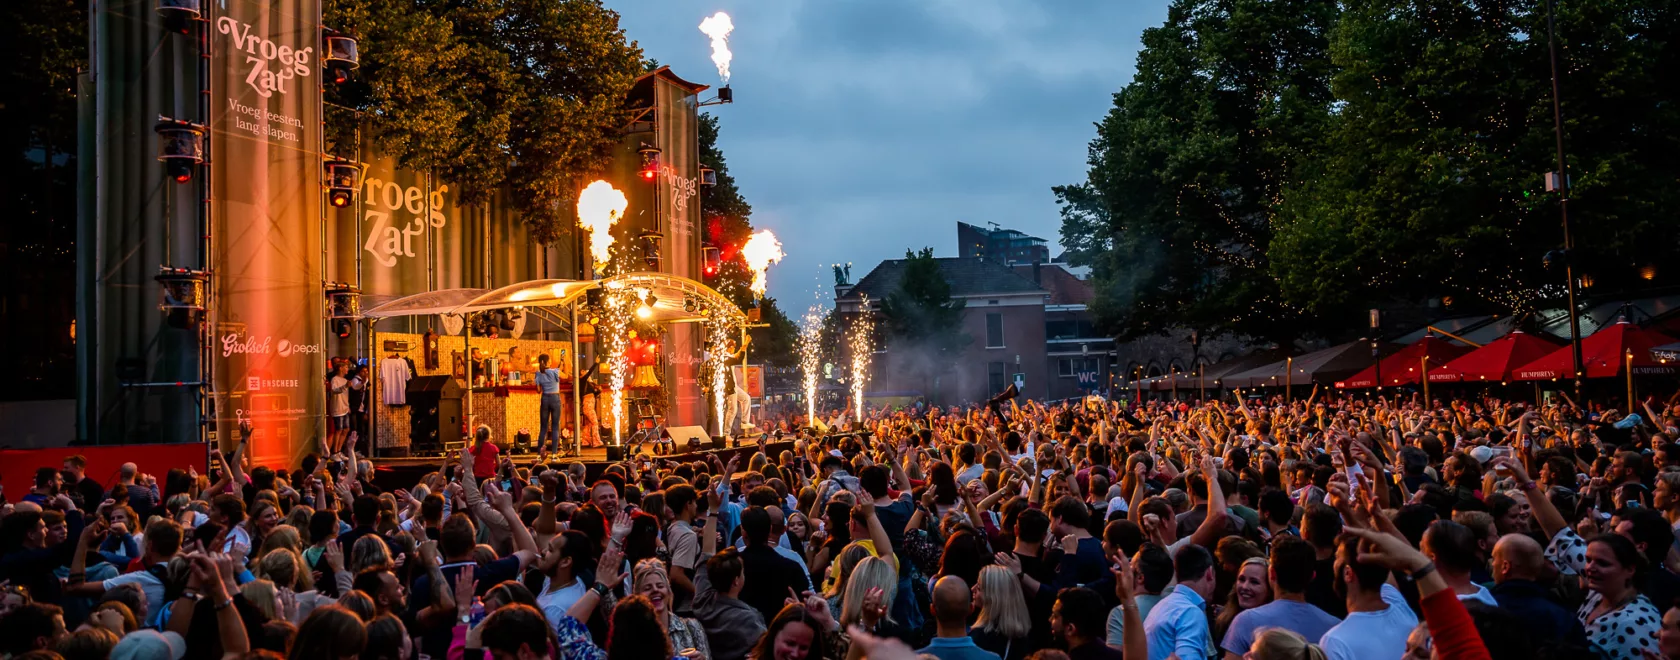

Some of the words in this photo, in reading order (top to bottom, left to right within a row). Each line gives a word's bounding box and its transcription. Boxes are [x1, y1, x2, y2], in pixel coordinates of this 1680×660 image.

[217, 16, 313, 77] Vroeg
[245, 55, 294, 98] Zat
[228, 97, 261, 120] Vroeg
[263, 107, 304, 129] feesten,
[235, 116, 260, 136] lang
[262, 124, 299, 142] slapen.
[662, 166, 697, 196] Vroeg
[672, 187, 690, 211] Zat
[364, 209, 424, 267] Zat
[221, 333, 271, 357] Grolsch
[293, 343, 320, 355] pepsi
[262, 379, 299, 388] ENSCHEDE
[1078, 371, 1097, 383] WC
